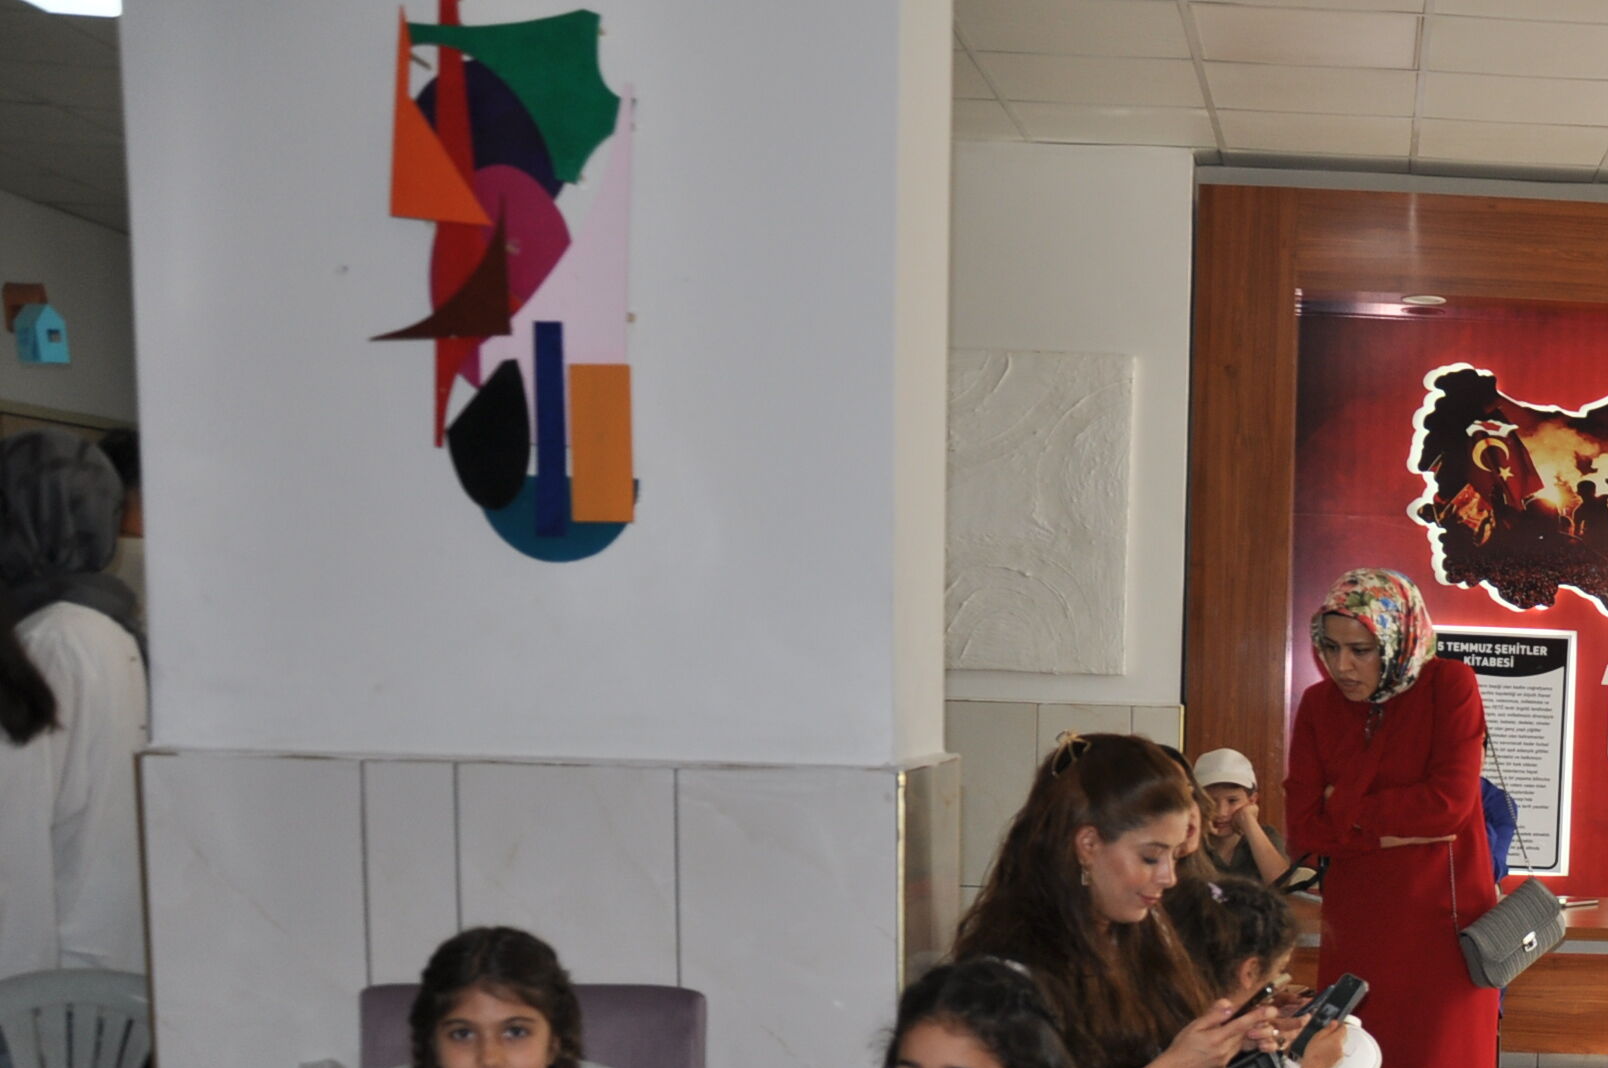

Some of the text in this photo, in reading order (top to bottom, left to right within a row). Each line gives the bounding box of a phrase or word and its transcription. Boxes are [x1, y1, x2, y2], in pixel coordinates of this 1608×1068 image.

[1447, 641, 1493, 654] TEMMUZ
[1495, 642, 1548, 656] ŞEHİTLER
[1464, 653, 1514, 668] KİTABESİ
